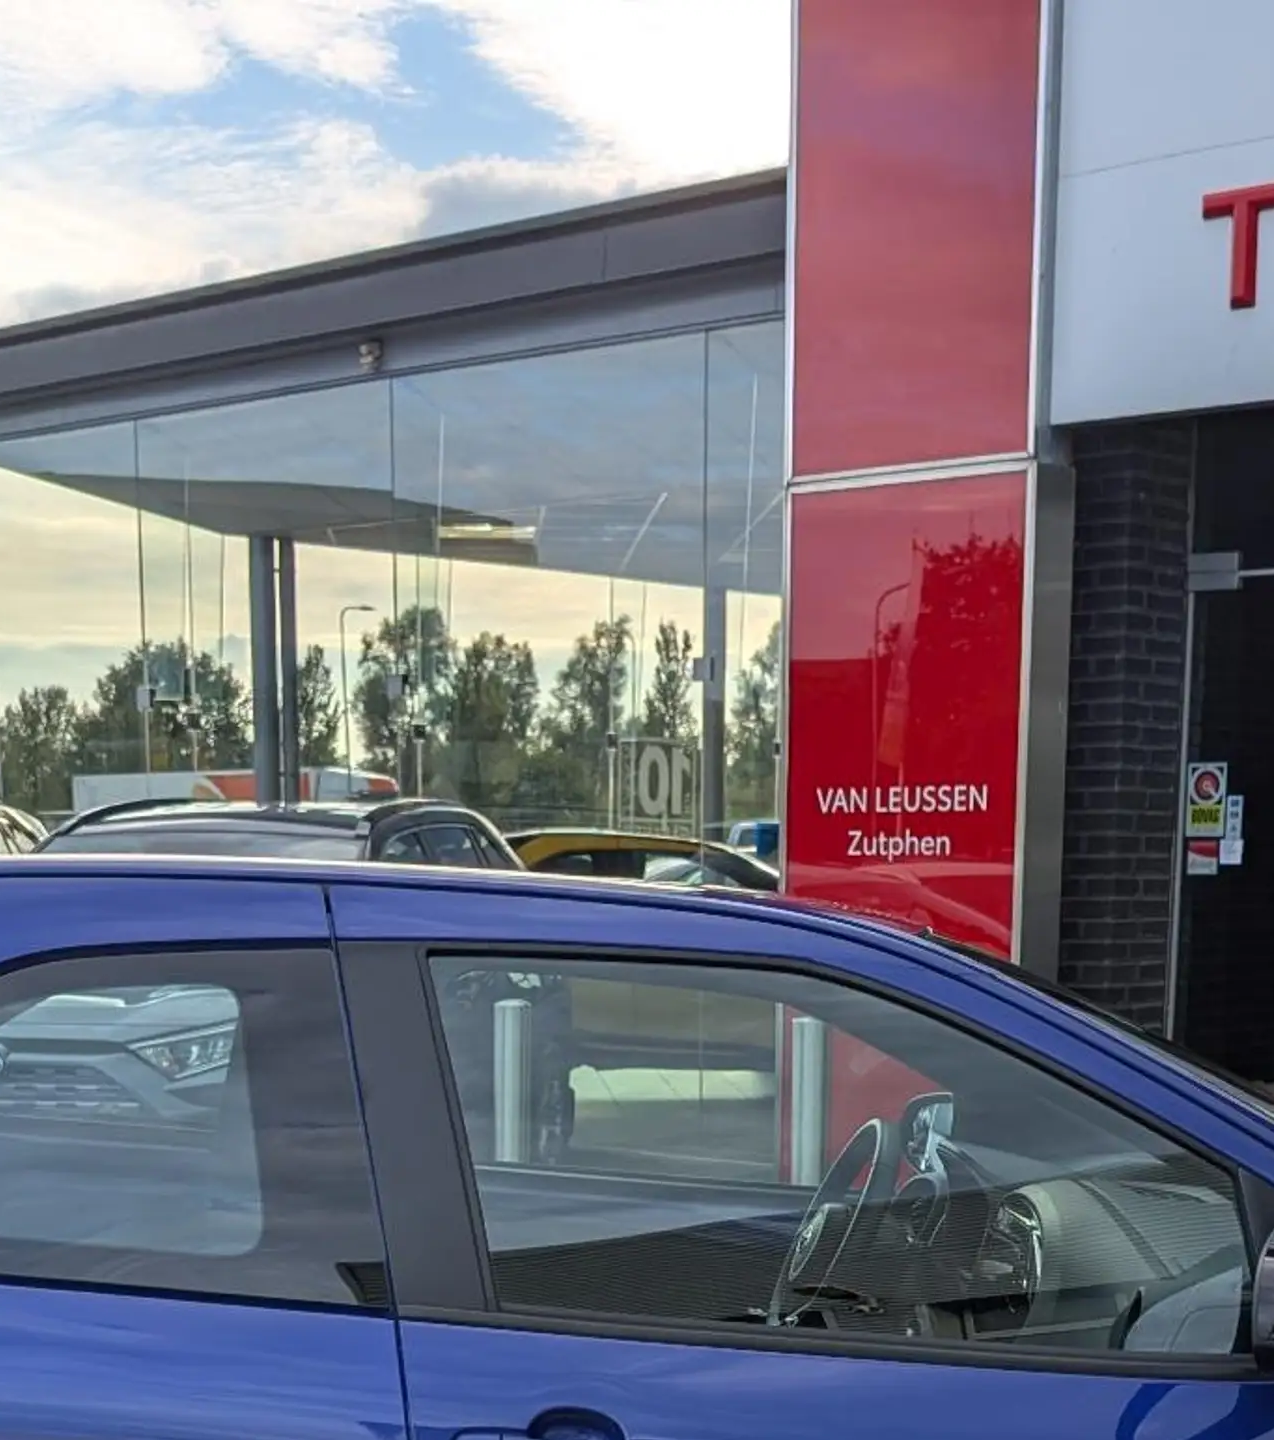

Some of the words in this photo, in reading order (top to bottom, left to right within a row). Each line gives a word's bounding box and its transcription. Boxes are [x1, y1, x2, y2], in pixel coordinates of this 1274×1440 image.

[816, 786, 868, 814] VAN
[875, 784, 988, 814] LEUSSEN
[847, 828, 951, 863] Zutphen
